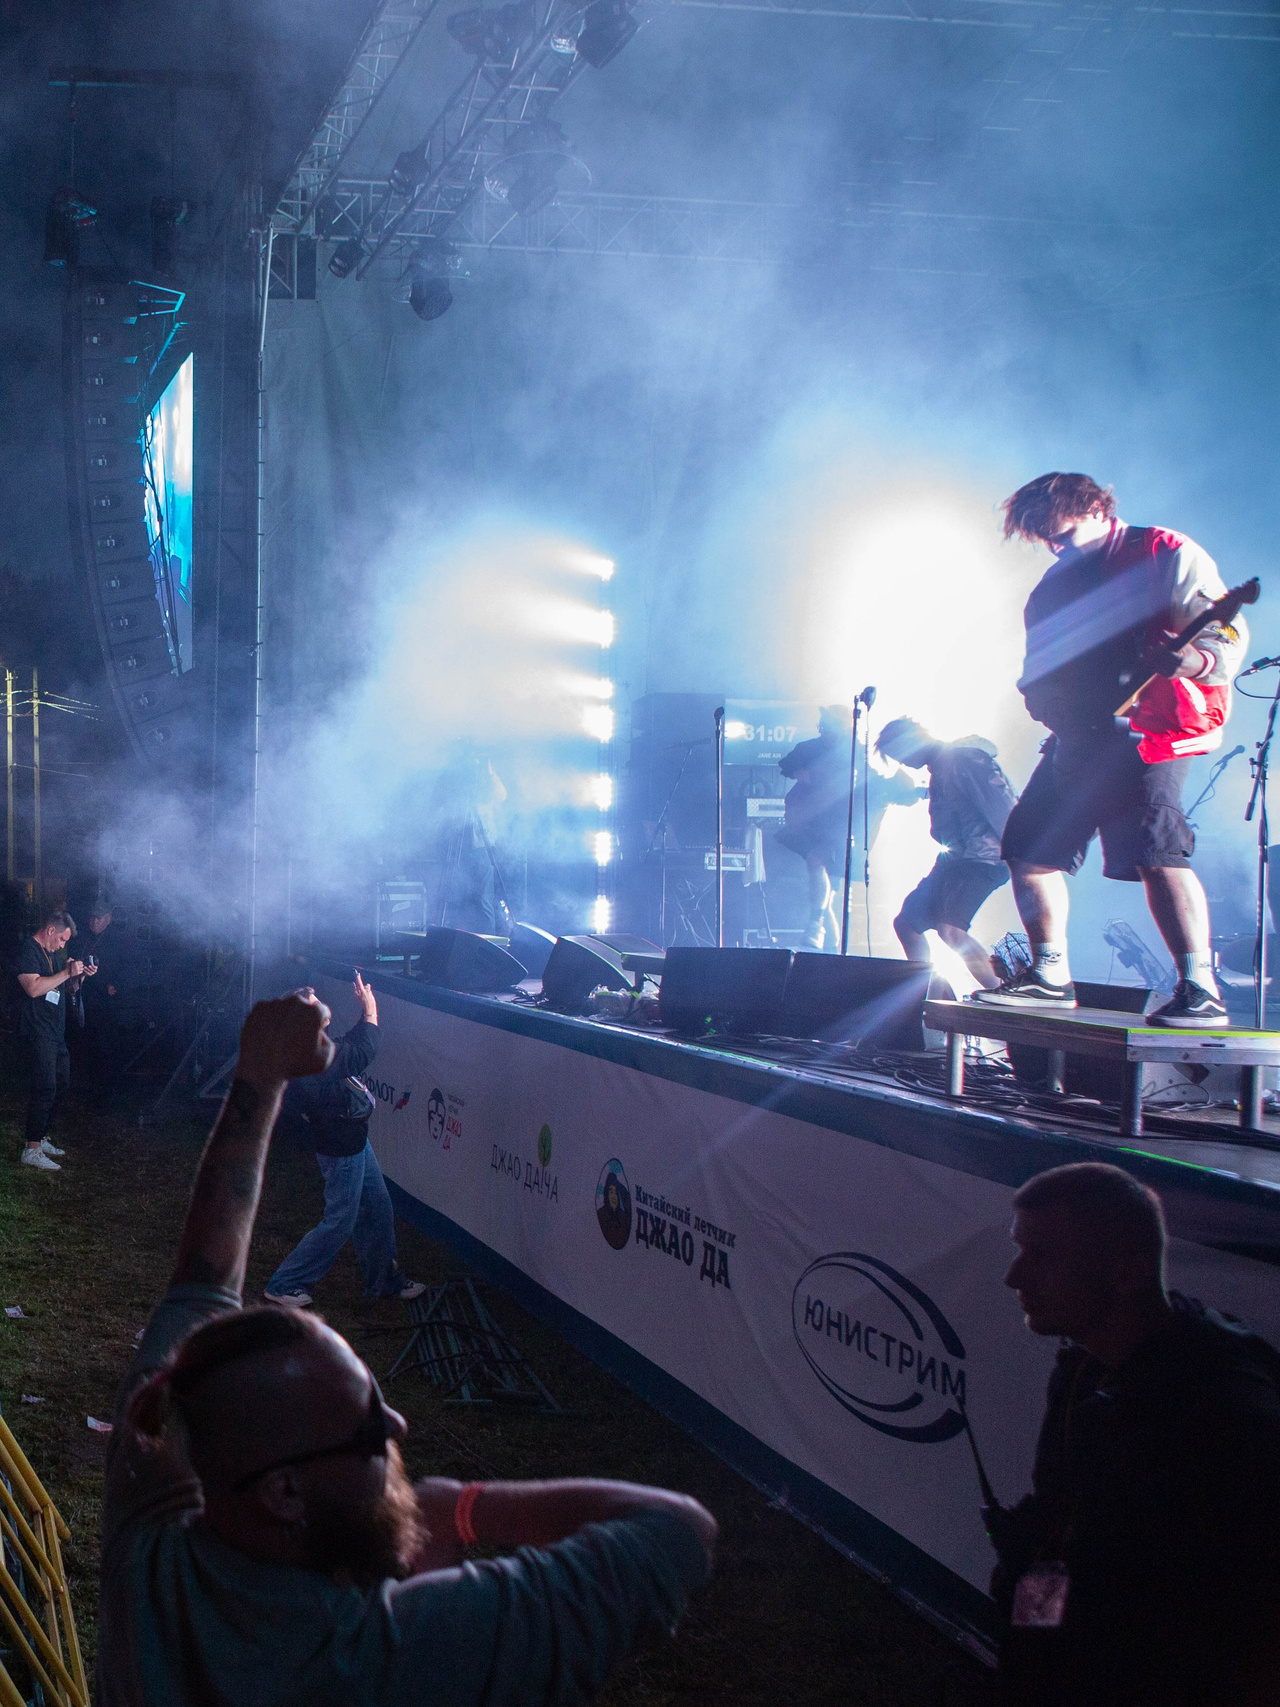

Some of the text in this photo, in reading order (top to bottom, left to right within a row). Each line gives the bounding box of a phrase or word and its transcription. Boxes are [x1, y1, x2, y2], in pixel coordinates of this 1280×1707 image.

[491, 1144, 521, 1181] ДЖАО
[635, 1184, 691, 1226] Китайский
[636, 1207, 731, 1289] ДЖАО ДА
[804, 1294, 966, 1405] ЮНИСТРИМ
